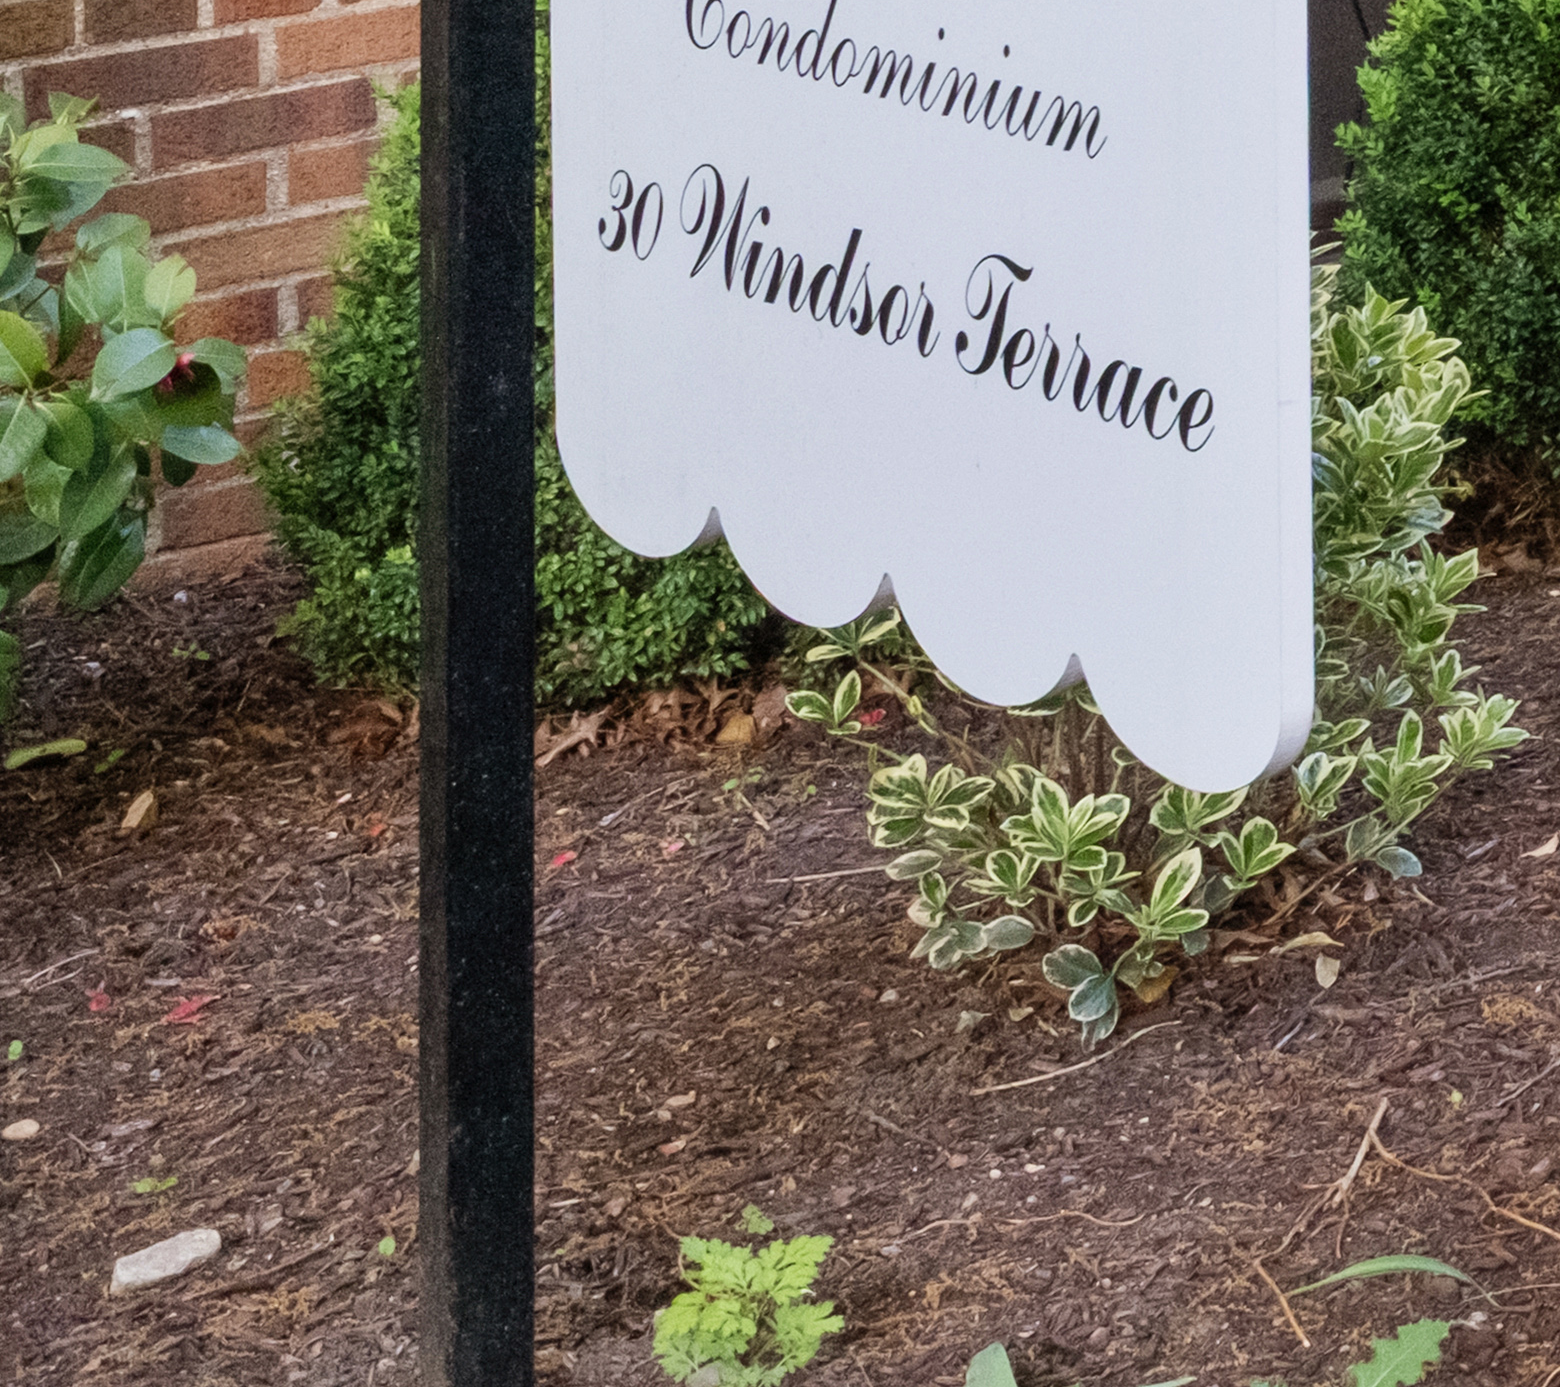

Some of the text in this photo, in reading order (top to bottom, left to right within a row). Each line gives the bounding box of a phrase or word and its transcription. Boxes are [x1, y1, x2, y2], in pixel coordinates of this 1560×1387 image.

[597, 163, 1218, 454] 30 Windsor Terrace
